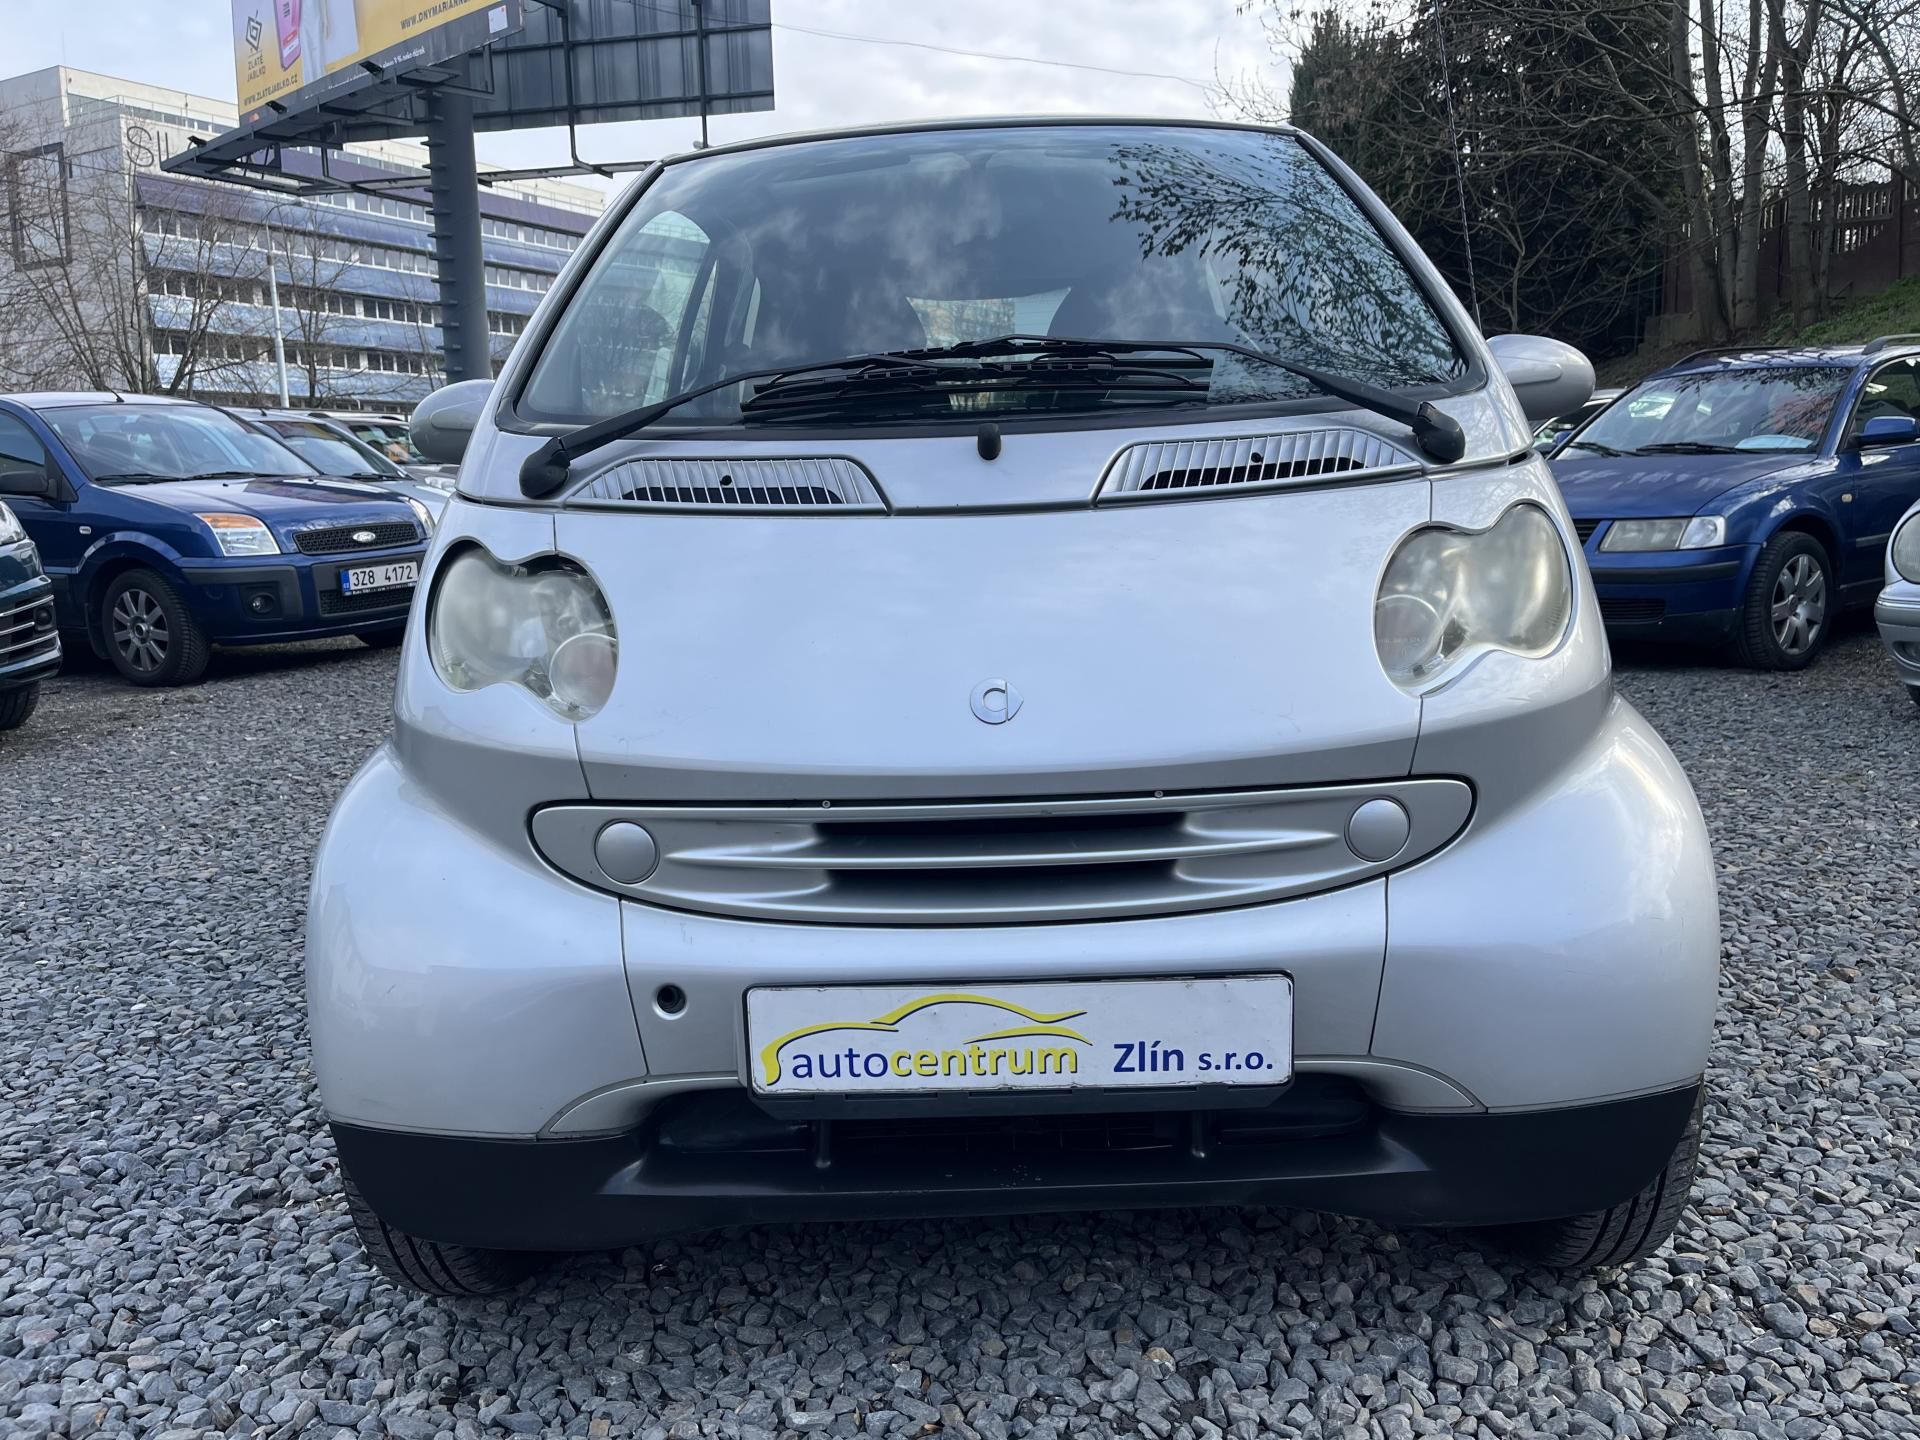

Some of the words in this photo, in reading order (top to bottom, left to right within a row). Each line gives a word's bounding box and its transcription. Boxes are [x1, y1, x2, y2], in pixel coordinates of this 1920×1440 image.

[247, 65, 267, 82] JABLKO
[352, 570, 375, 586] 3Z8
[384, 565, 412, 582] 4172
[791, 1043, 1078, 1080] autocentrum
[1113, 1041, 1184, 1074] Zlín
[1198, 1050, 1273, 1071] s.r.o.
